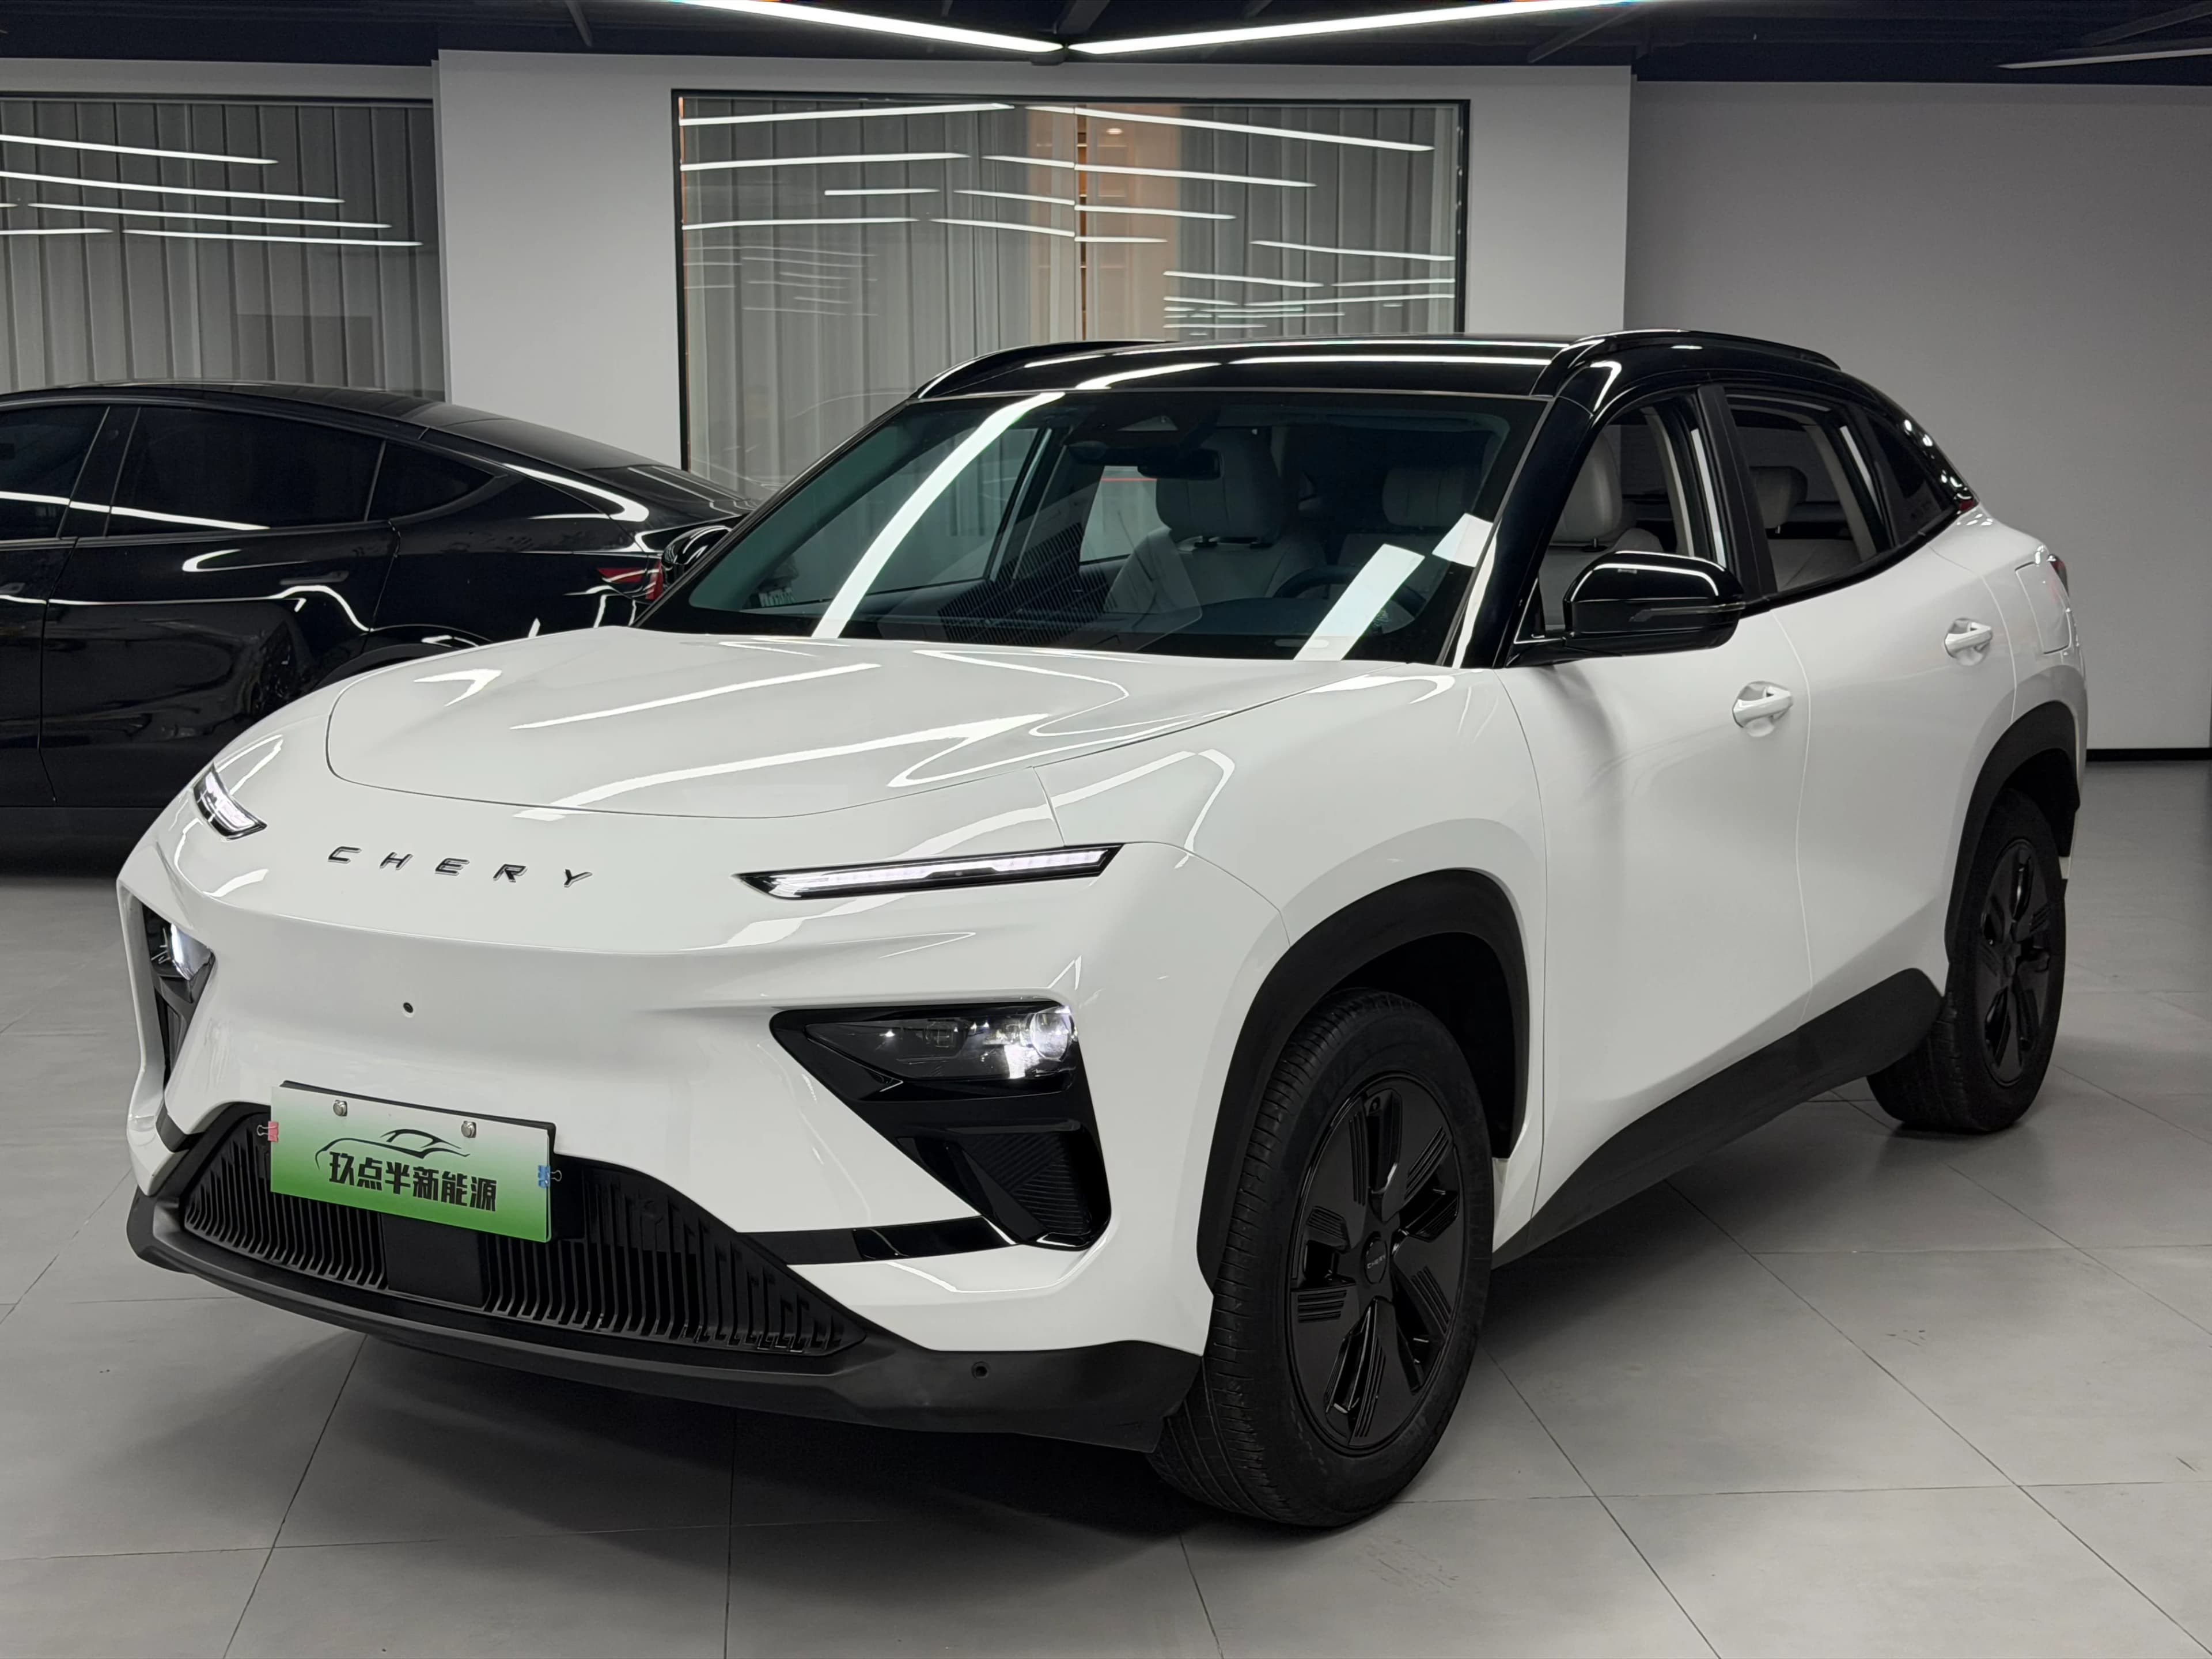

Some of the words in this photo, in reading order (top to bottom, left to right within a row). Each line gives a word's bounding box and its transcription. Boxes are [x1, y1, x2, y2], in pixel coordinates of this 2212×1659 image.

[328, 846, 593, 888] CHERY
[329, 1151, 497, 1211] 玖点半新能源
